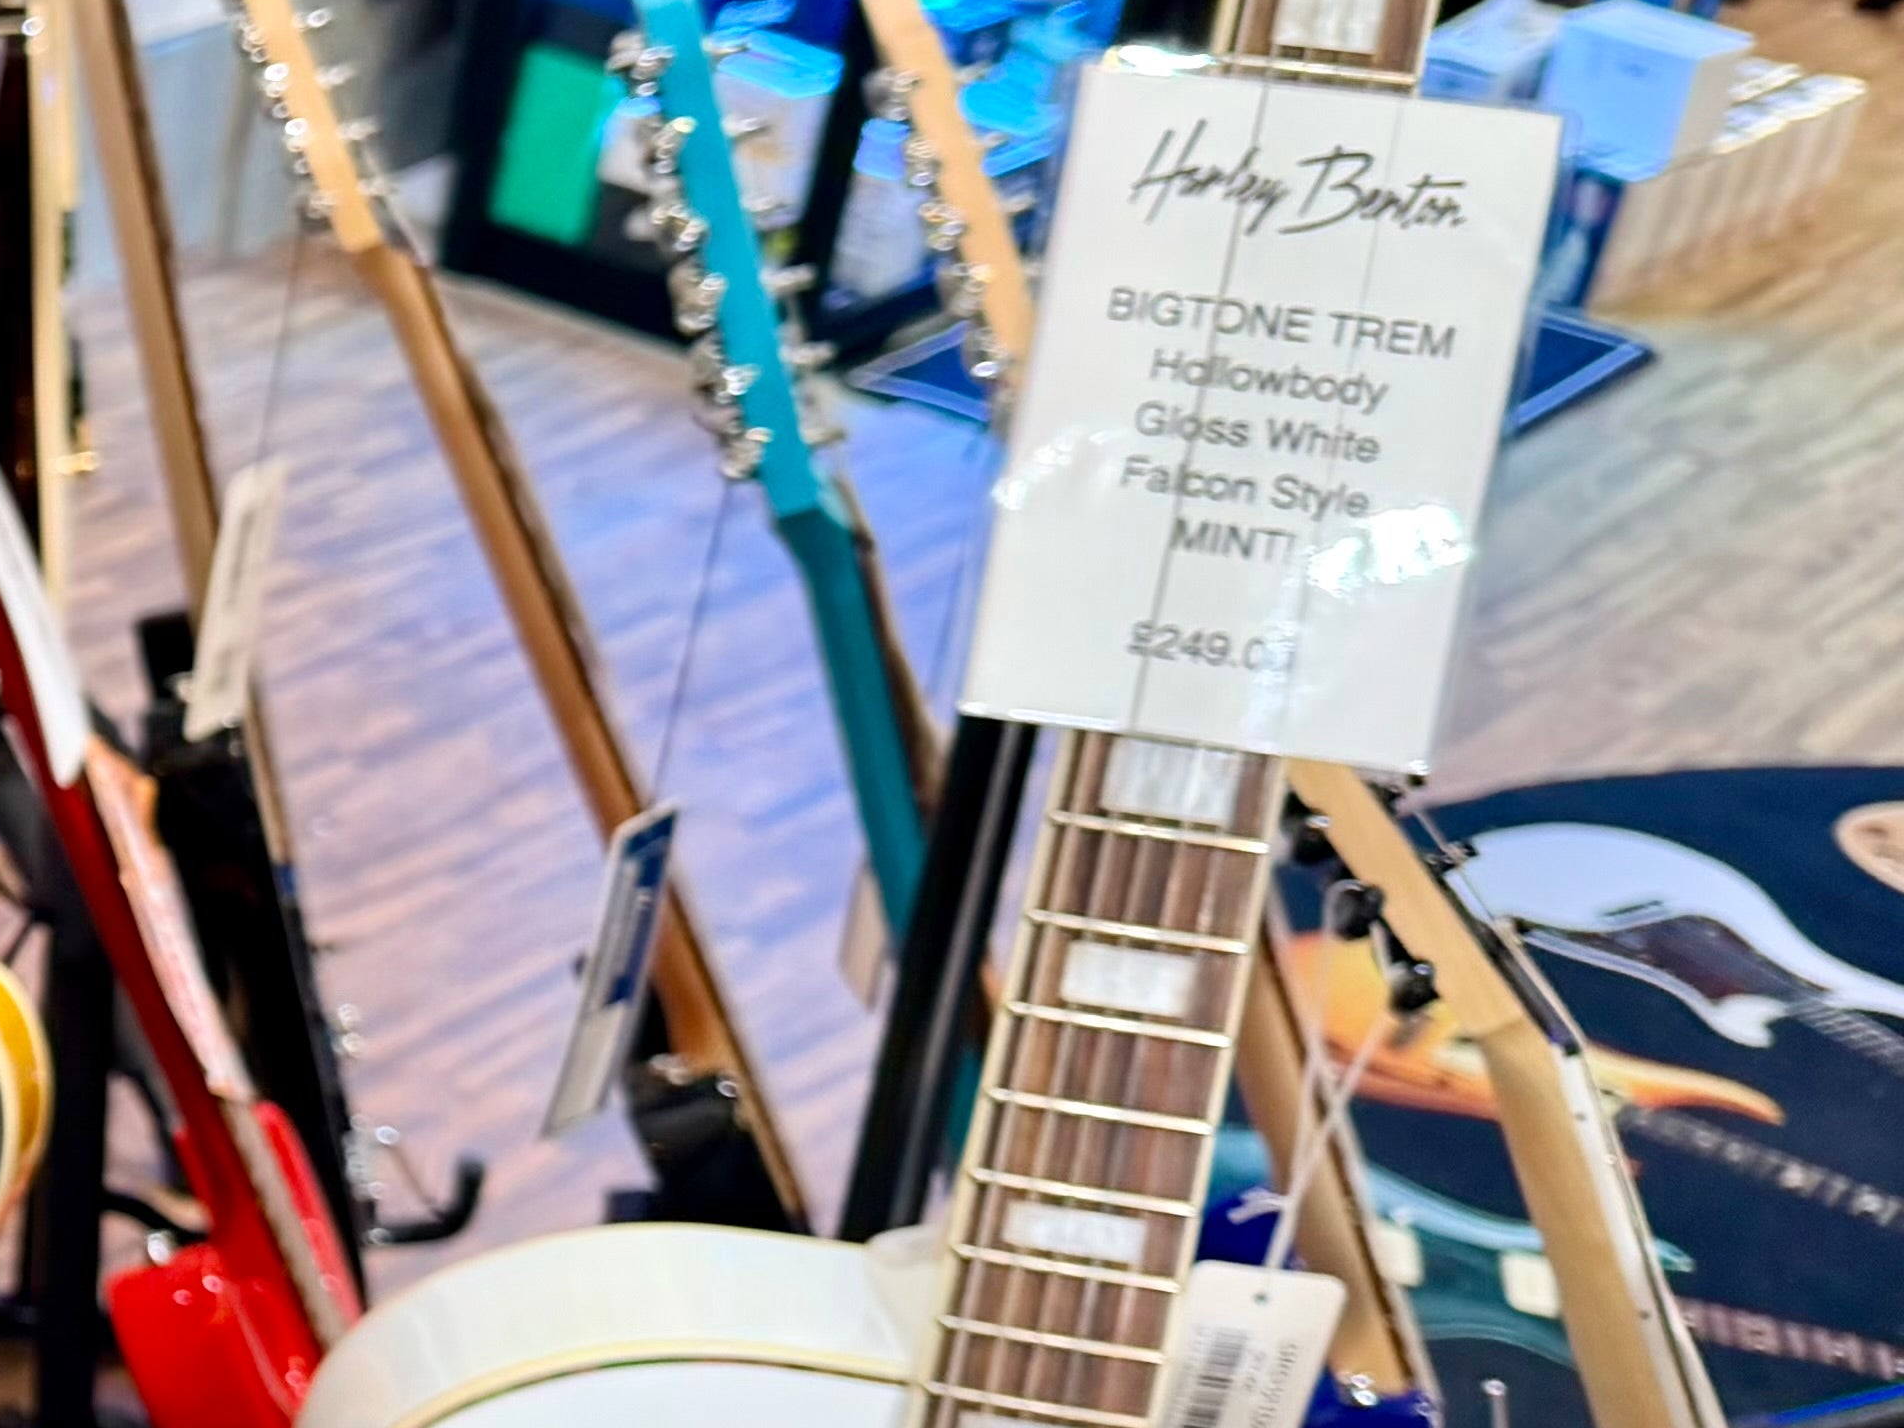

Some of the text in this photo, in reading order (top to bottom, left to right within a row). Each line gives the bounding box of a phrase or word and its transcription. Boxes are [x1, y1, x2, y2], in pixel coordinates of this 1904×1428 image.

[1129, 120, 1469, 234] Harley Benton
[1108, 287, 1456, 360] BIGTONE TREM
[1149, 348, 1388, 414] Hollowbody
[1135, 401, 1380, 464] Gloss White
[1120, 457, 1370, 521] Falcon Style
[1127, 621, 1295, 671] £249.0
